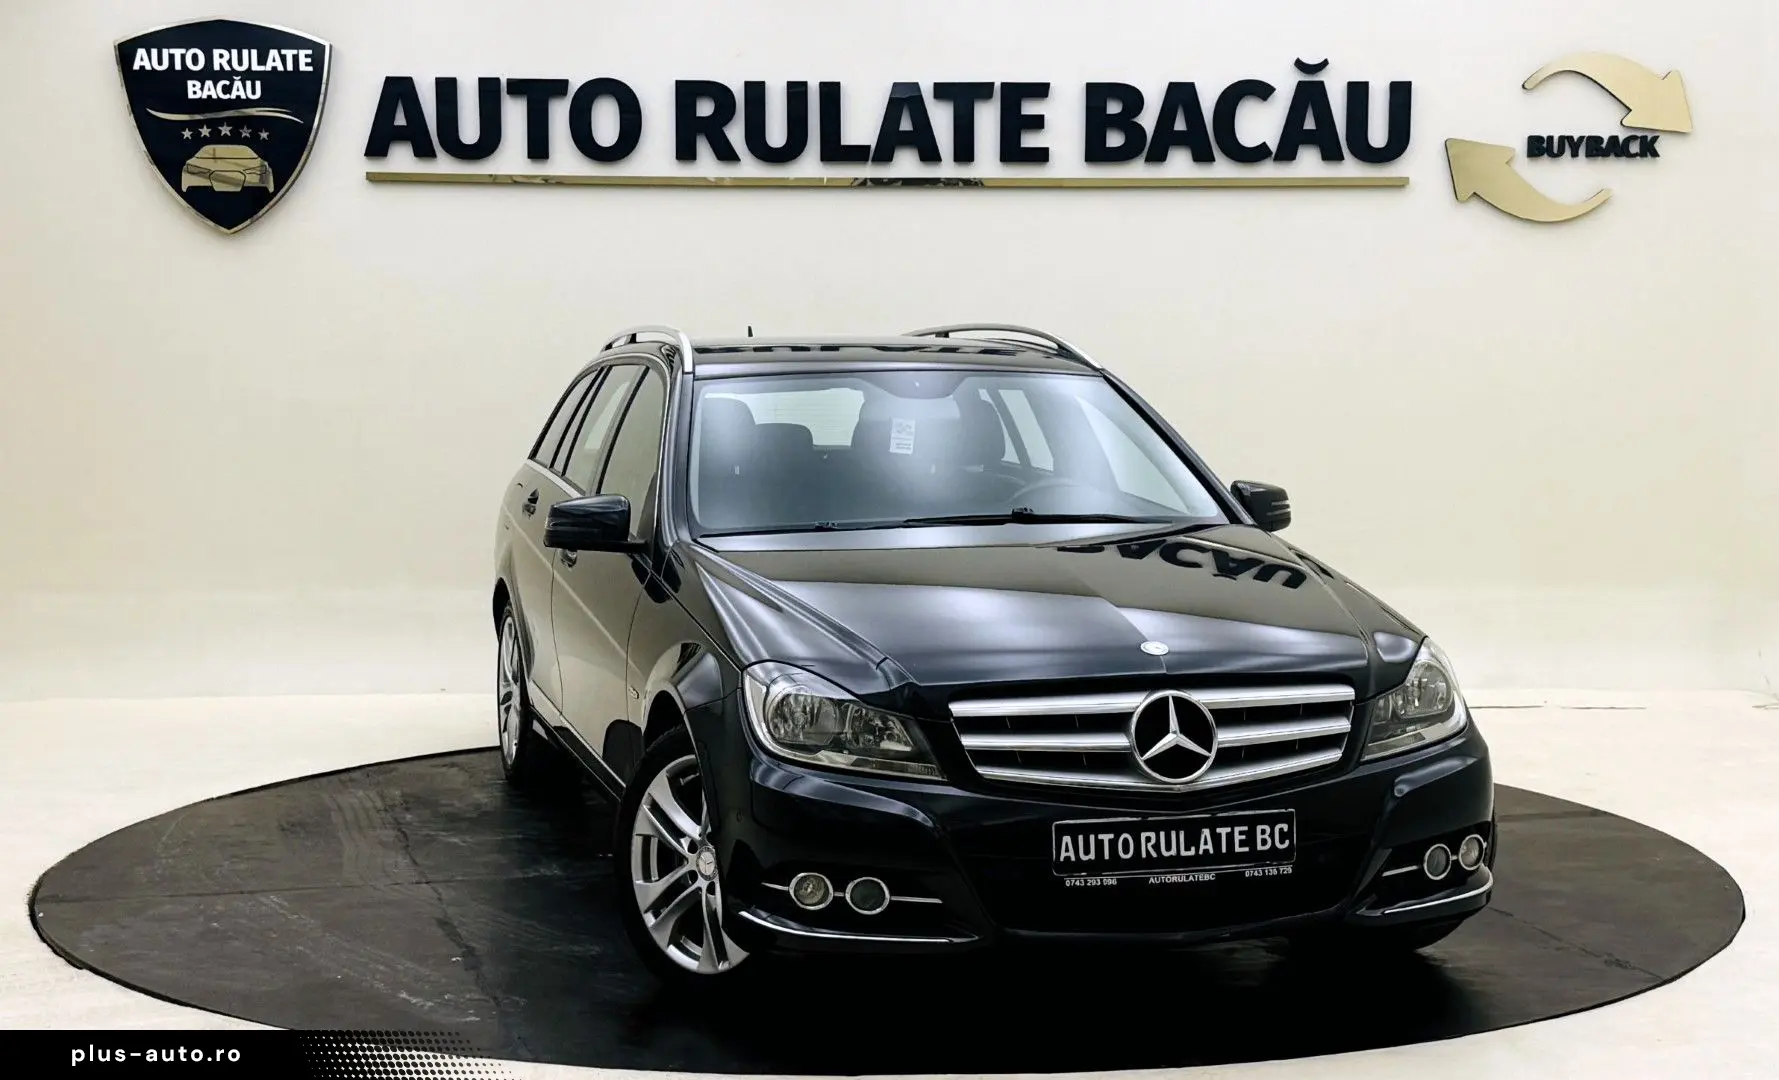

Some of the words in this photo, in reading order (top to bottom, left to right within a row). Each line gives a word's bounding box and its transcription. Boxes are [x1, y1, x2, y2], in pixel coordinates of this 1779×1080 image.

[133, 48, 205, 72] AUTO
[212, 48, 314, 72] RULATE
[187, 76, 262, 100] BACĂU
[363, 75, 643, 163] AUTO
[674, 79, 1051, 165] RULATE
[1085, 57, 1412, 164] BACĂU
[1526, 134, 1661, 159] BUYBACK
[1060, 832, 1134, 861] AUTO
[1140, 826, 1249, 859] RULATE
[1256, 823, 1290, 851] BC
[1149, 873, 1216, 884] AUTORULATEBC
